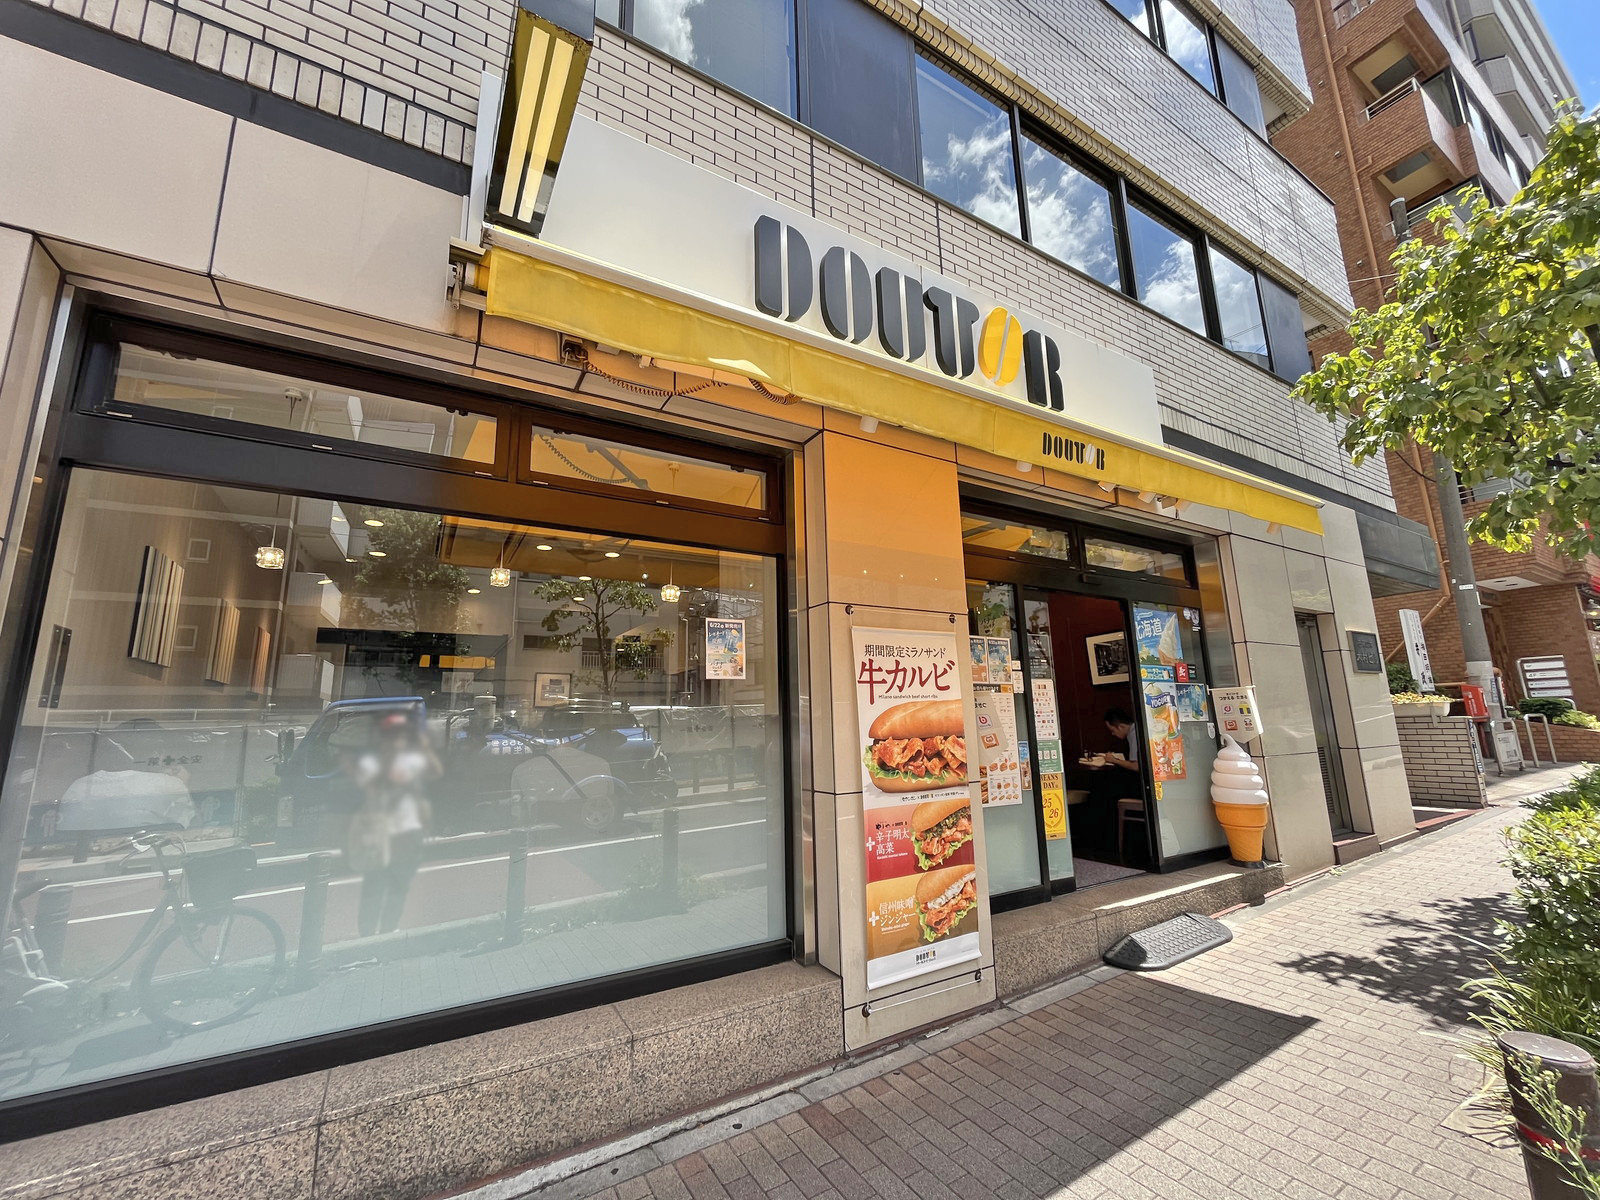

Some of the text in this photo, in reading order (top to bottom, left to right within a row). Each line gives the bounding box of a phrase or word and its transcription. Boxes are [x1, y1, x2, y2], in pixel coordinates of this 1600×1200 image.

[753, 214, 1065, 412] DOUTOR
[1042, 431, 1106, 471] DOUTOR
[864, 643, 946, 659] 期間限定ミラノサンド
[857, 658, 956, 705] 牛カルビ
[1042, 798, 1052, 809] 25
[1049, 808, 1059, 819] 26
[876, 842, 894, 856] 高菜
[880, 911, 916, 927] ジンジャー
